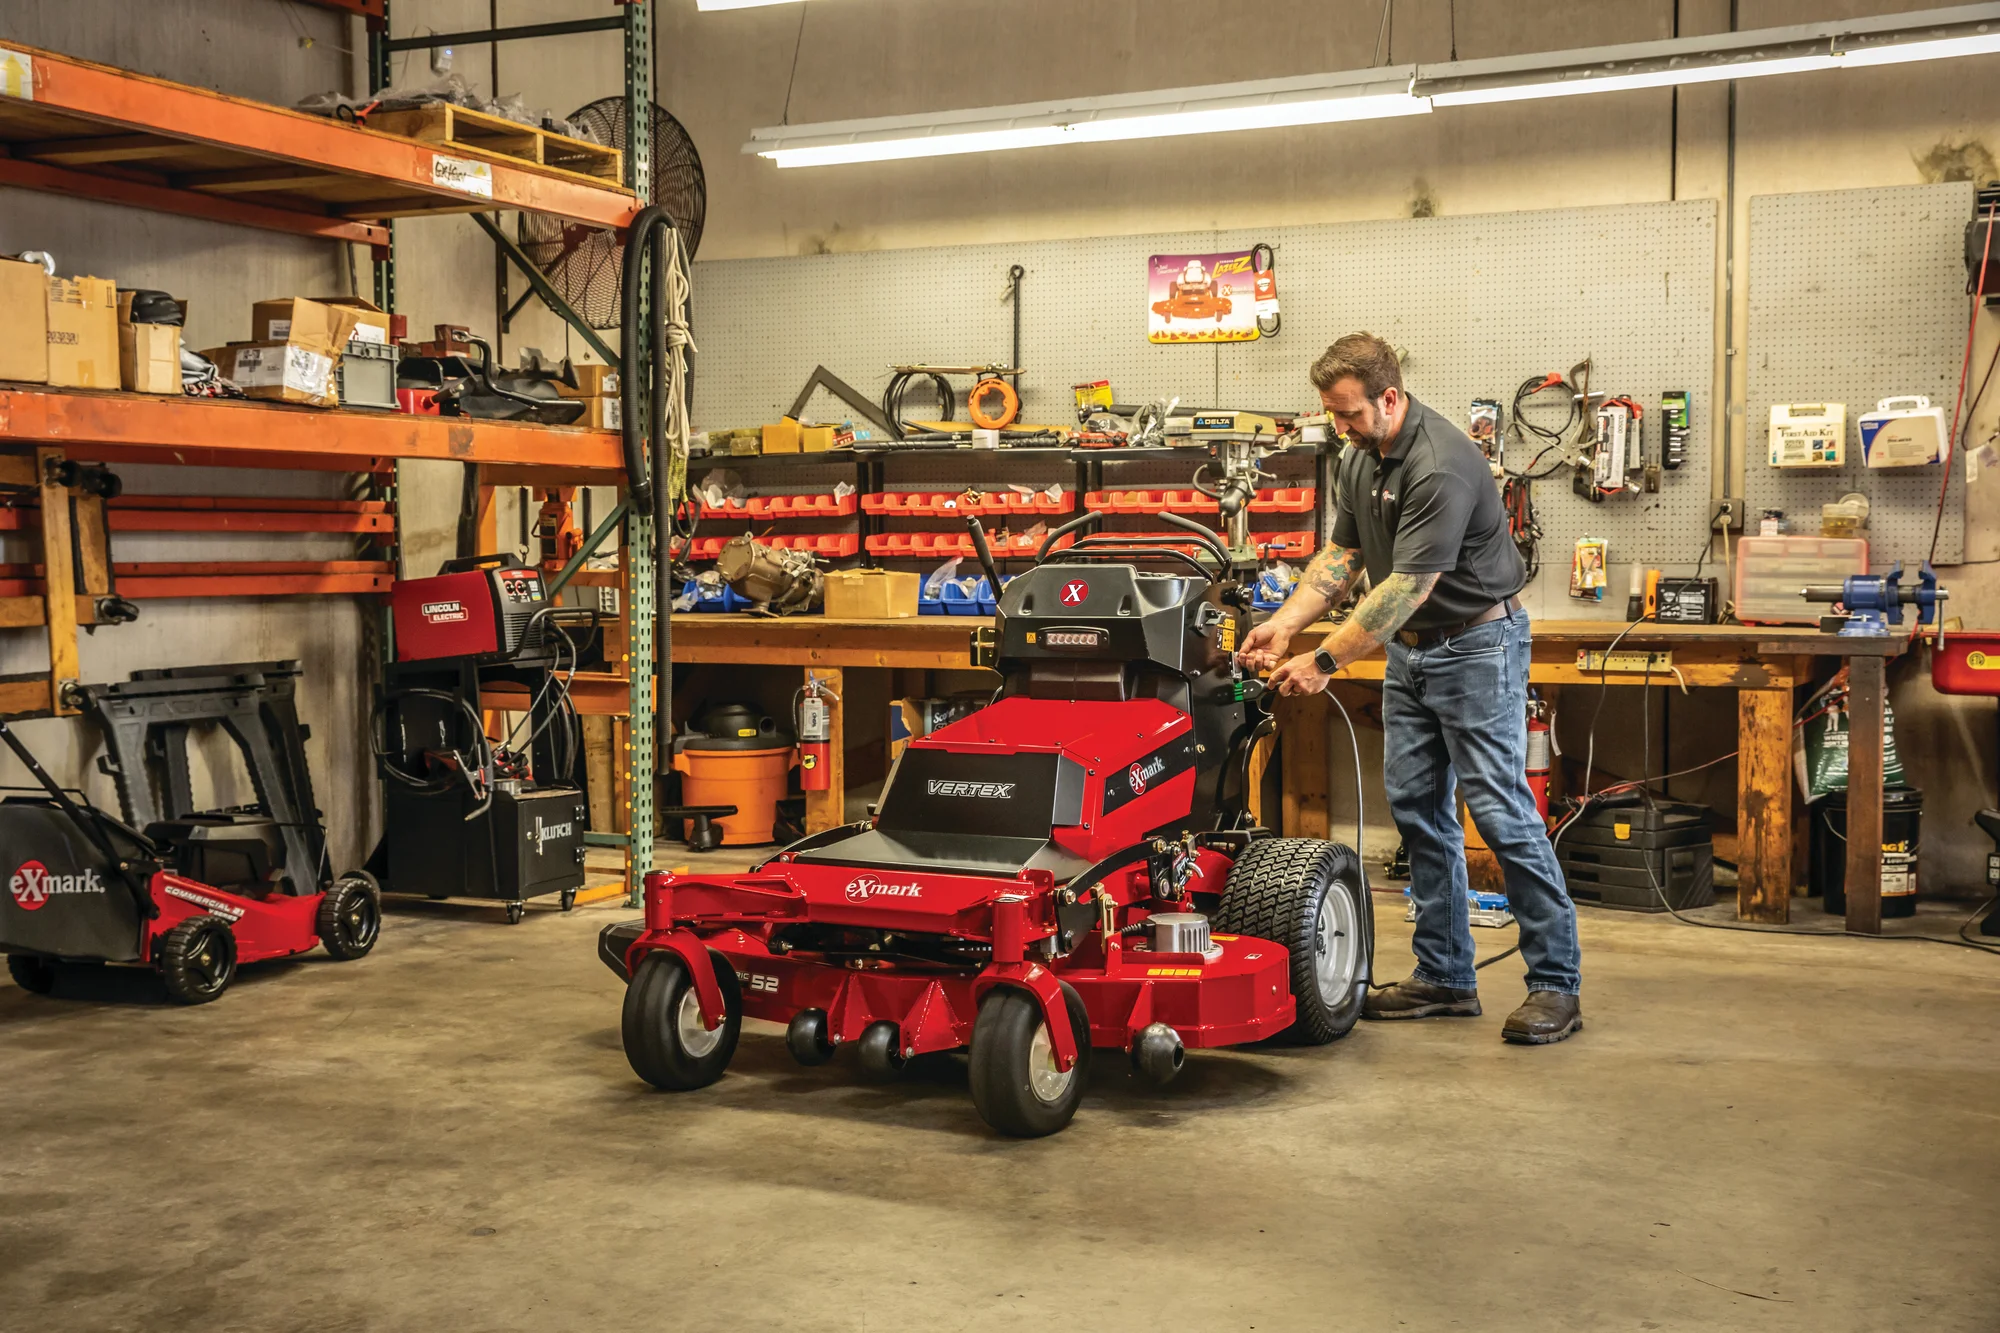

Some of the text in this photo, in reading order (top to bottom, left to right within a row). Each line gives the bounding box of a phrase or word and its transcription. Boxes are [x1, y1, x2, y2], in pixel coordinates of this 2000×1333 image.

[1063, 584, 1084, 602] X
[424, 602, 460, 614] LINCOLN
[433, 612, 464, 621] ELECTRIC
[1130, 756, 1166, 791] eXmark
[928, 780, 1016, 799] VERTEX
[541, 822, 572, 841] KLUTCH
[846, 879, 922, 898] eXmark
[164, 885, 231, 912] COMMERCIAL
[751, 974, 780, 992] 52
